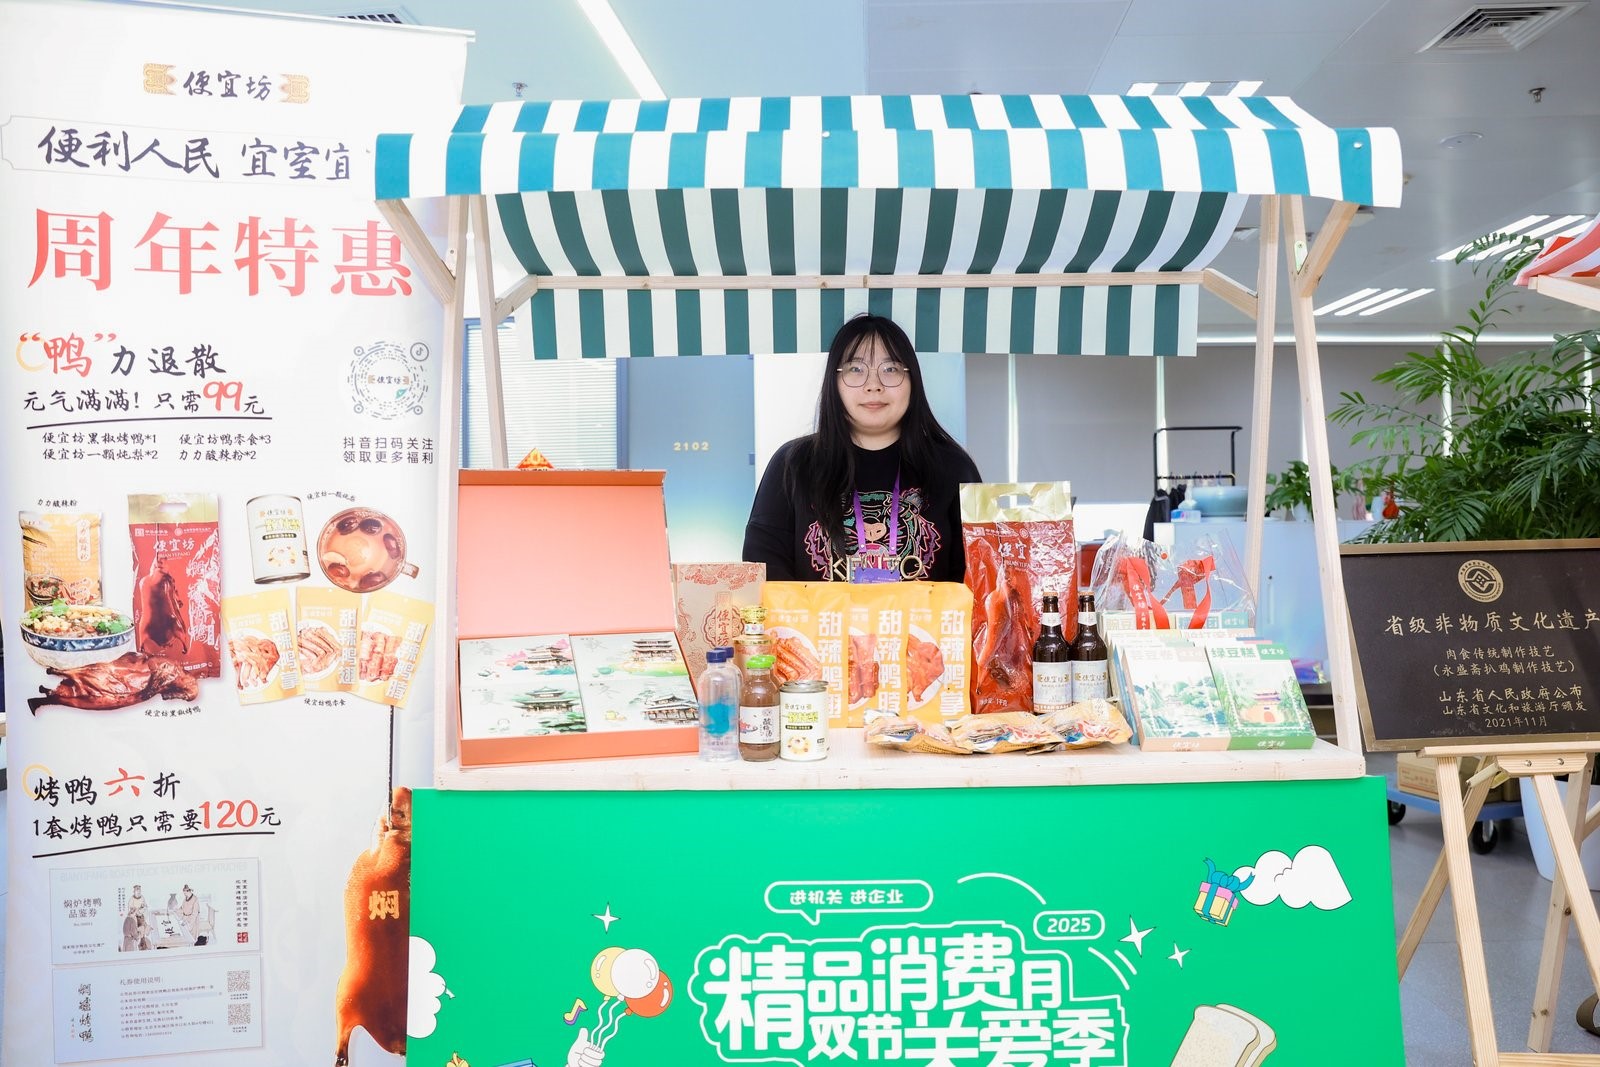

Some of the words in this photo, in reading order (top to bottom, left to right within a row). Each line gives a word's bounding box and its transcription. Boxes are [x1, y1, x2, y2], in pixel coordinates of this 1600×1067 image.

[183, 70, 272, 101] 便宜坊
[38, 126, 220, 179] 便利人民
[241, 137, 353, 181] 宜室宜
[28, 208, 412, 298] 周年特惠
[343, 437, 434, 450] 抖音扫码关注
[673, 442, 709, 451] 2102
[343, 451, 434, 465] 领取更多福利
[153, 537, 196, 552] 便宜坊
[830, 555, 923, 581] KEO
[1384, 608, 1600, 637] 省级非物质文化遗产
[1211, 647, 1256, 659] 绿豆糕
[1446, 646, 1555, 661] 肉食传统制作技艺
[1439, 684, 1582, 703] 山东省人民政府公布
[1442, 700, 1587, 715] 山东省文化和旅游厅颁发
[1485, 716, 1547, 728] 2021年11月
[34, 768, 181, 806] 烤鸭六折
[34, 800, 282, 839] 1套烤鸭只需要120元
[63, 897, 102, 909] 焖炉烤鸭
[368, 889, 400, 920] 焖
[789, 889, 843, 904] 进机关
[850, 889, 904, 905] 进企业
[1046, 917, 1092, 933] 2025
[703, 932, 1062, 1050] 精品消费月
